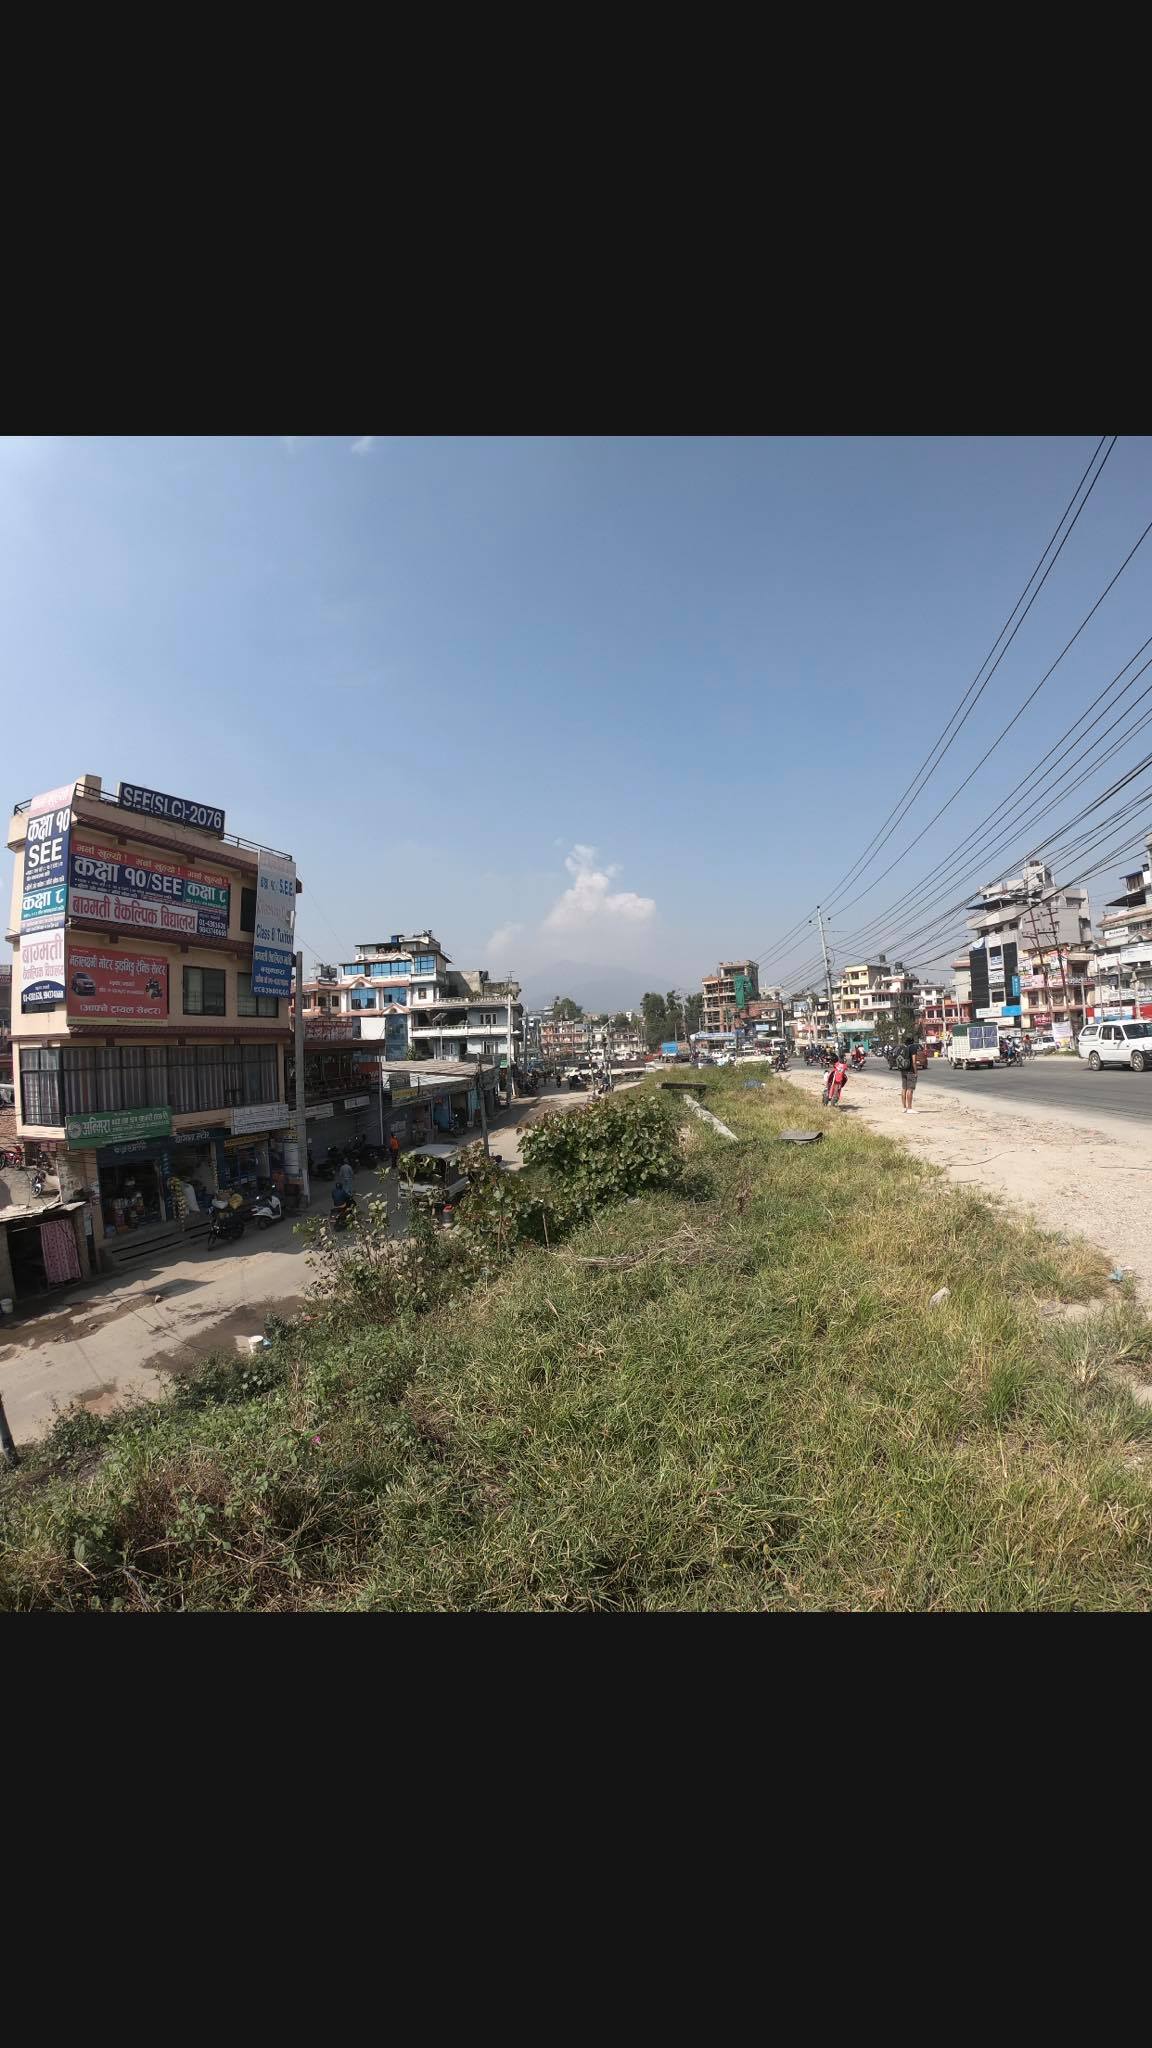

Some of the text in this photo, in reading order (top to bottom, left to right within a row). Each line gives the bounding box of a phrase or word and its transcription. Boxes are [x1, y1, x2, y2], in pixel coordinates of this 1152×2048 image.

[123, 786, 222, 829] SEE(SLC)-2076
[27, 808, 71, 841] कक्षा १०
[28, 837, 63, 868] SEE
[74, 855, 120, 885] कक्षा
[23, 891, 52, 911] कक्षा
[187, 881, 216, 902] कक्षा
[72, 895, 111, 918] बाग्मती
[114, 896, 158, 926] वैकल्पिक
[160, 904, 197, 931] विद्यालय
[22, 932, 63, 963] बाग्मती
